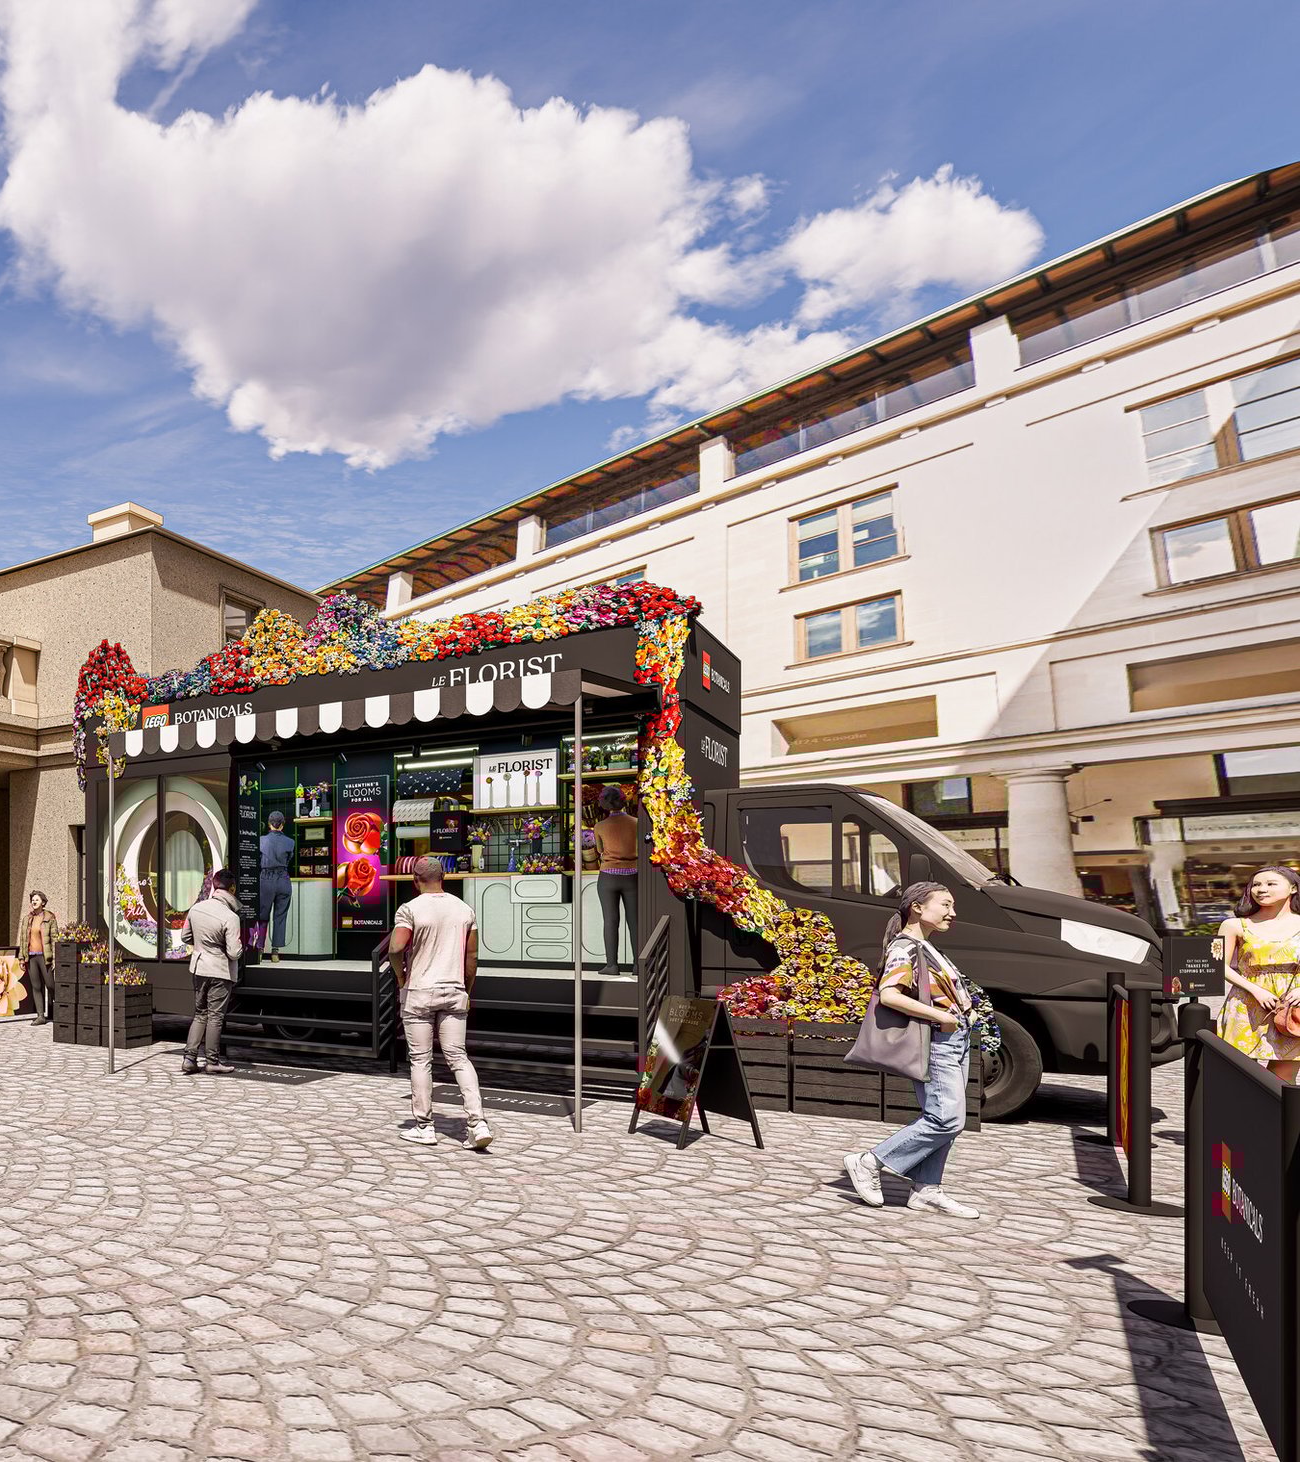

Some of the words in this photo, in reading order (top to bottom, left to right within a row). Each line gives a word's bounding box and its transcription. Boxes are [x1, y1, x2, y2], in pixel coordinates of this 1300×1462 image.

[431, 675, 447, 688] LE
[449, 653, 563, 688] FLORIST
[143, 714, 168, 729] LEGO
[174, 702, 253, 726] BOTANICALS
[705, 735, 728, 768] FLORIST
[488, 765, 497, 773] LE
[497, 758, 553, 774] FLORIST
[342, 786, 382, 798] BLOOMS
[669, 1008, 703, 1020] BLOOMS
[1231, 1177, 1264, 1244] BOTANICALS
